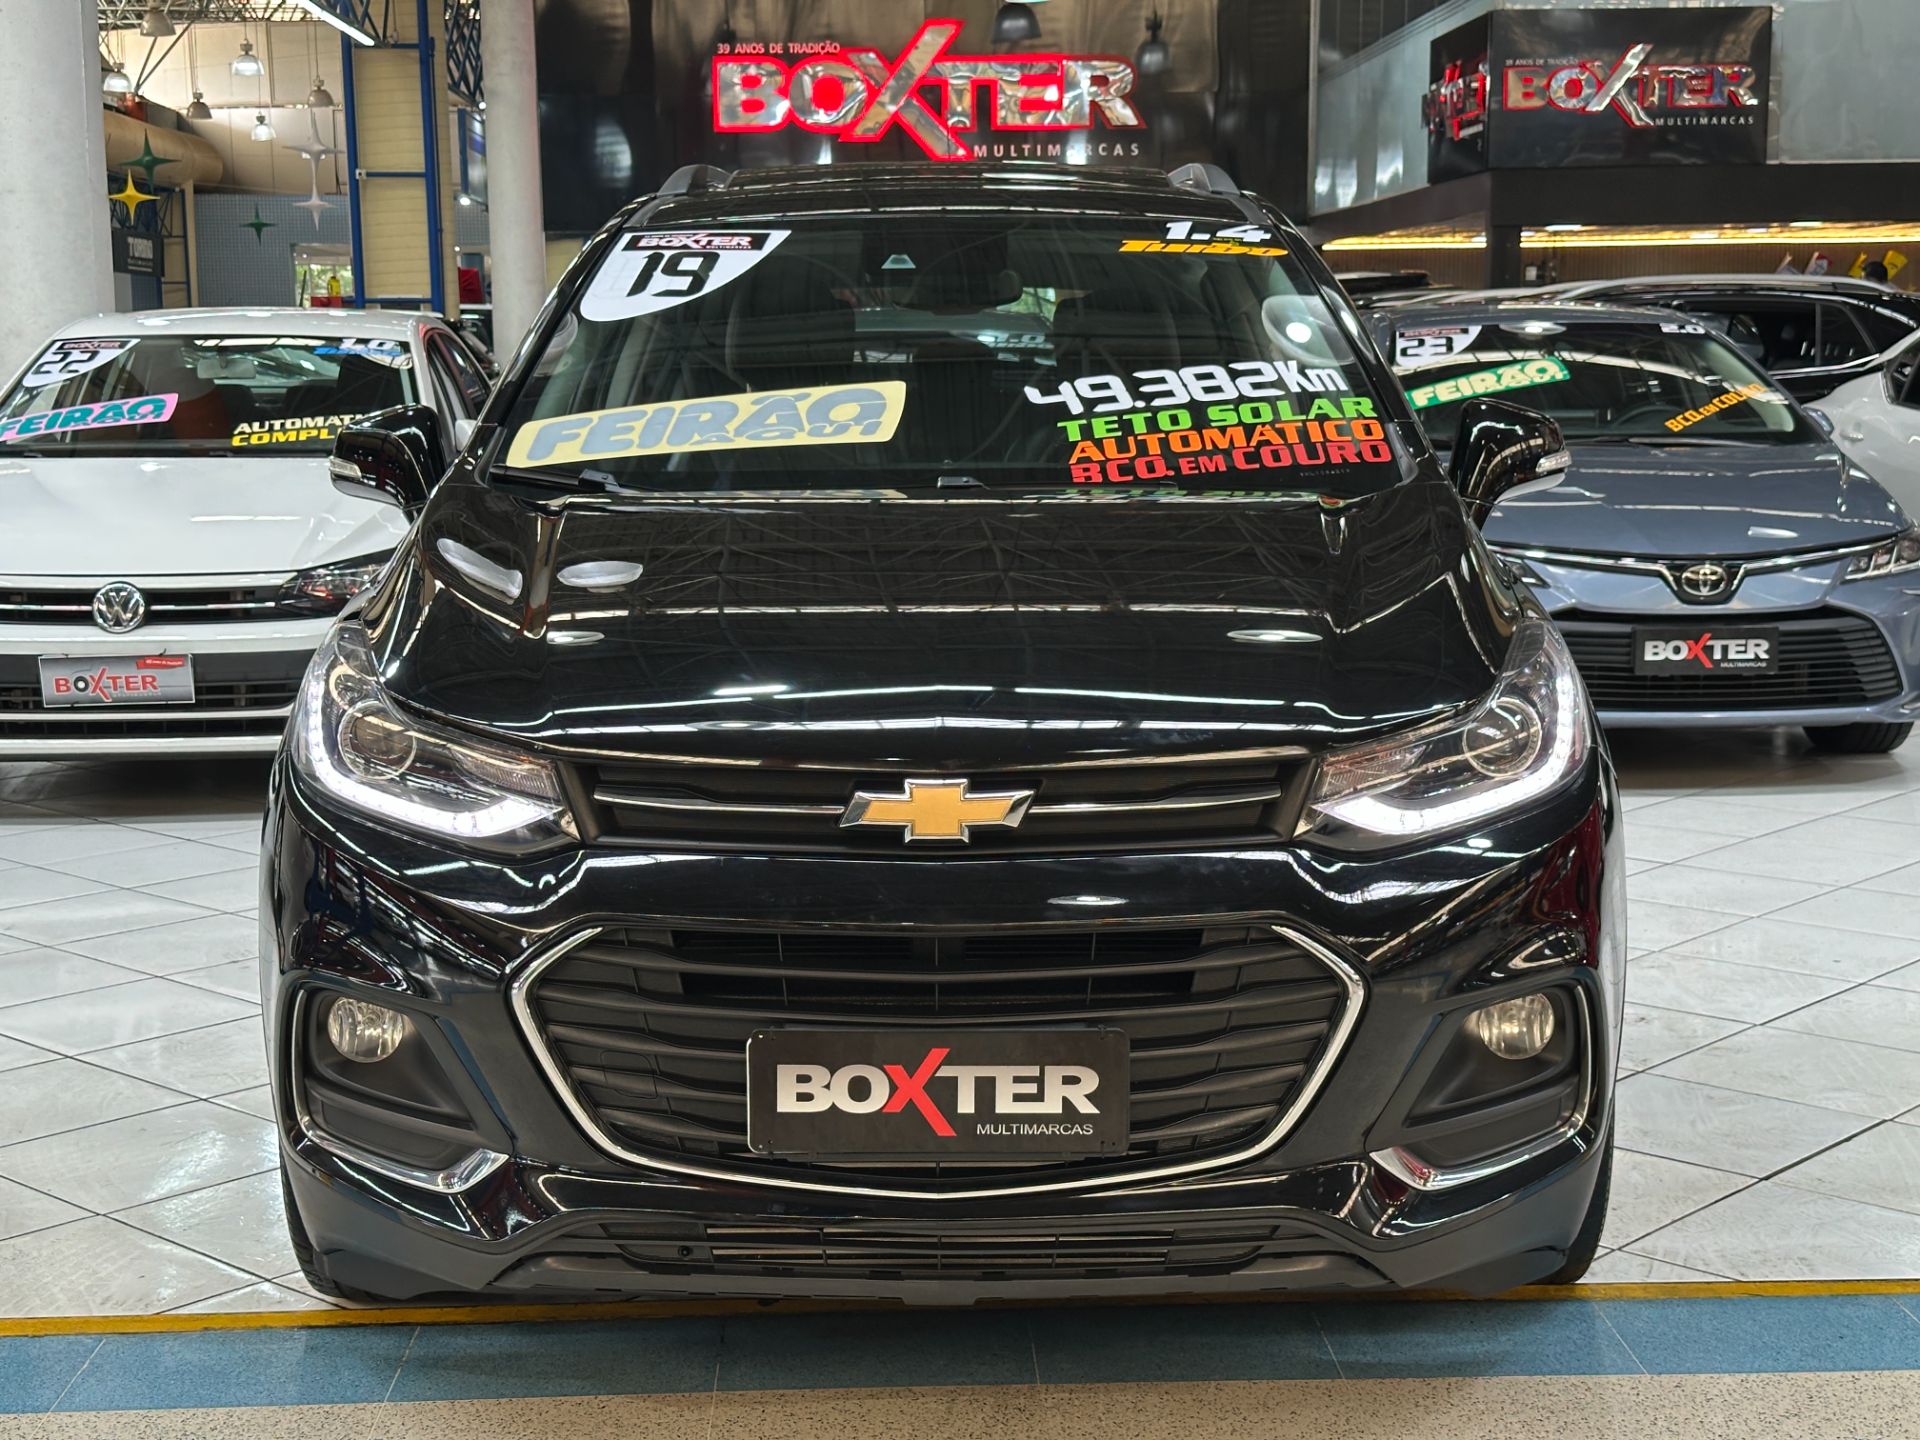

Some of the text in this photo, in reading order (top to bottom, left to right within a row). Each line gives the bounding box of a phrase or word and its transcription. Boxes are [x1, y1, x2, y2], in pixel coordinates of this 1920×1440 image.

[717, 40, 840, 55] 39 ANOS DE TRADIÇÃO
[712, 18, 1147, 161] BOXTER
[1503, 43, 1759, 128] BOXTER
[1654, 116, 1755, 127] MULTIMARCAS
[973, 143, 1140, 158] MULTIMARCAS
[637, 233, 752, 249] BOXTER
[1119, 239, 1289, 257] Turbo
[1165, 221, 1272, 242] 1.4
[626, 251, 721, 298] 19
[31, 350, 101, 376] 22
[1400, 336, 1454, 357] 23
[1411, 359, 1564, 407] FEIRÃO
[0, 397, 167, 439] FEIRÃO
[527, 387, 887, 462] FEIRÃO
[1057, 396, 1378, 442] TETO SOLAR
[231, 427, 342, 447] COMPL
[1180, 454, 1227, 475] EM
[1232, 440, 1393, 471] COURO
[1644, 633, 1770, 668] BOXTER
[54, 666, 159, 702] BOXTER
[776, 1047, 1101, 1137] BOXTER
[976, 1123, 1094, 1136] MULTIMARCAS
